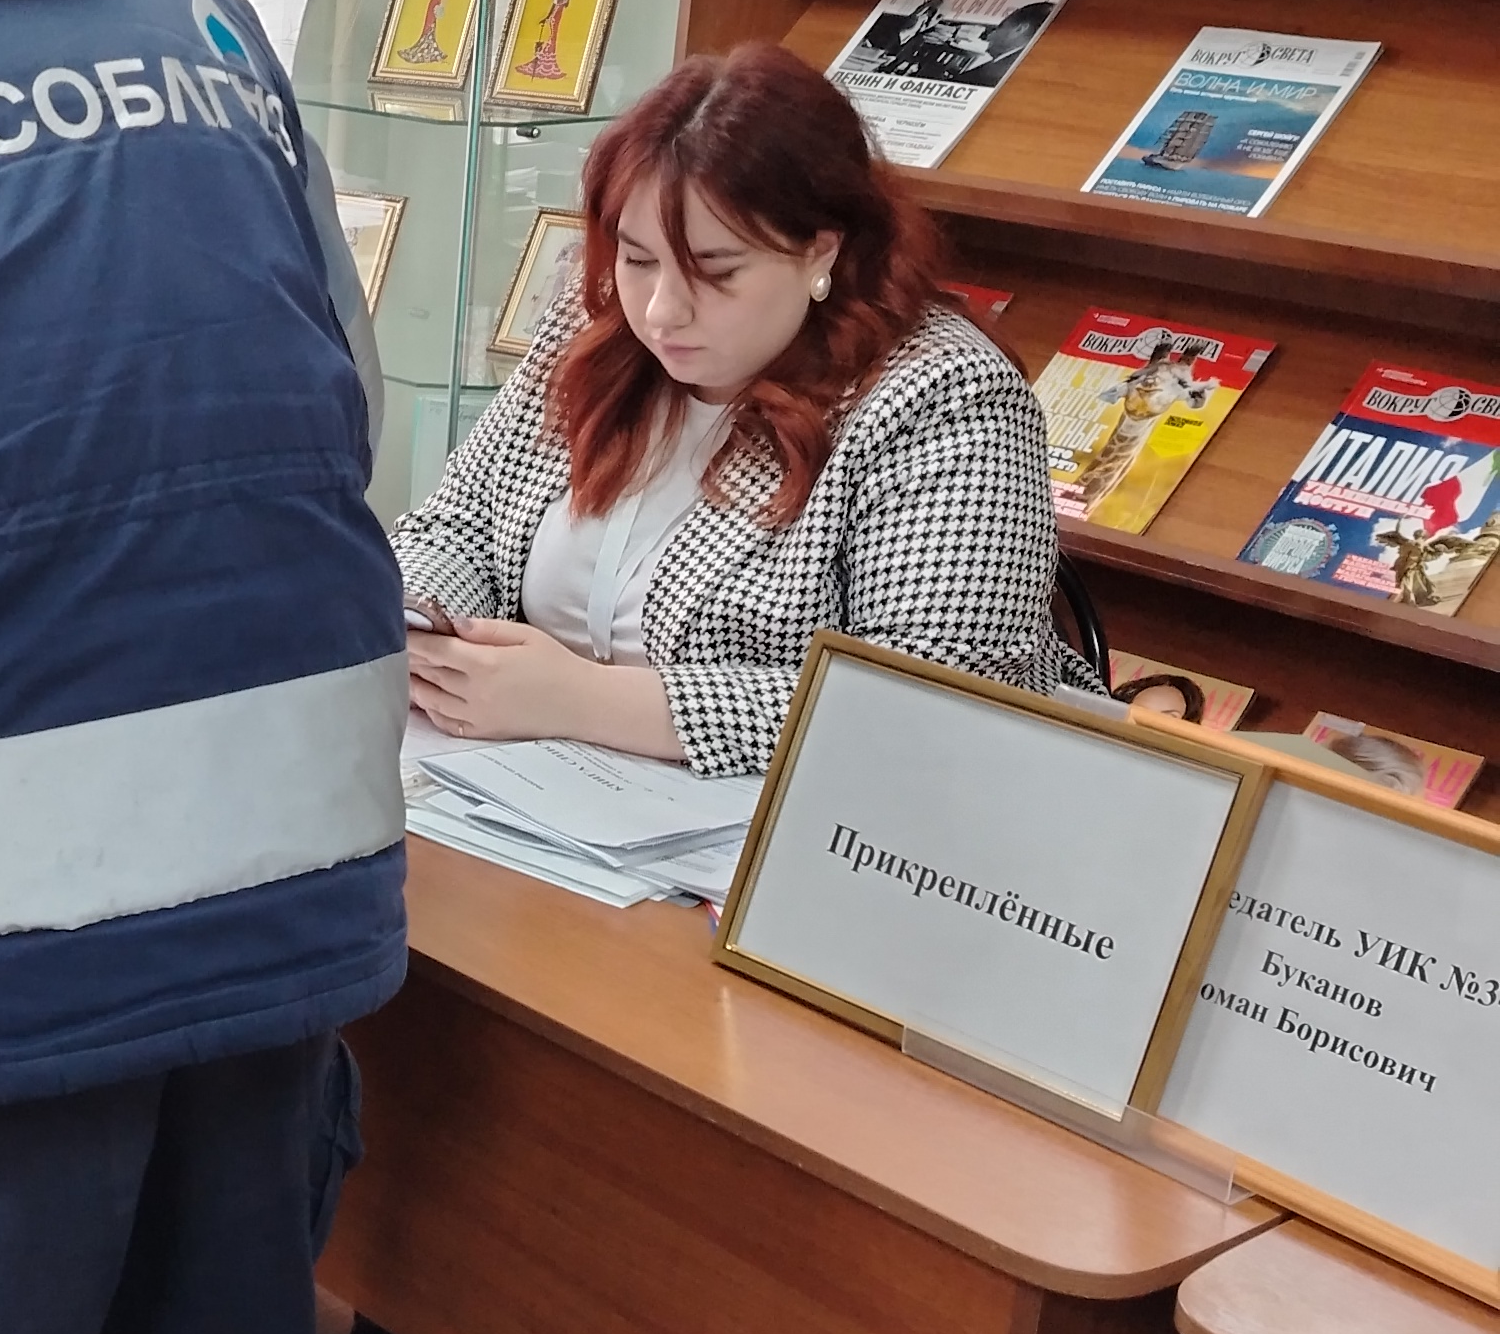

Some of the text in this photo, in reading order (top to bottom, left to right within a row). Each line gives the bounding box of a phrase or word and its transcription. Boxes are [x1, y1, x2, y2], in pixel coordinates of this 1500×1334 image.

[1191, 47, 1315, 66] ВОКРУГ СВЕТА
[831, 71, 884, 88] ЛЕНИН
[883, 77, 899, 90] И
[900, 80, 978, 101] ФАНТАСТ
[1173, 72, 1241, 94] ВОЛНА
[1246, 80, 1264, 95] И
[1268, 84, 1317, 100] МИР
[1081, 332, 1144, 354] ВОКРУГ
[1366, 389, 1438, 414] ВОКРУГ
[1292, 422, 1469, 505] ИТАЛИЯ
[1294, 492, 1376, 519] ДОСТУП
[827, 822, 1116, 960] Прикреплённые
[1229, 890, 1500, 1007] едатель УИК №3
[1259, 949, 1383, 1018] Буканов
[1200, 982, 1438, 1094] оман Борисович
